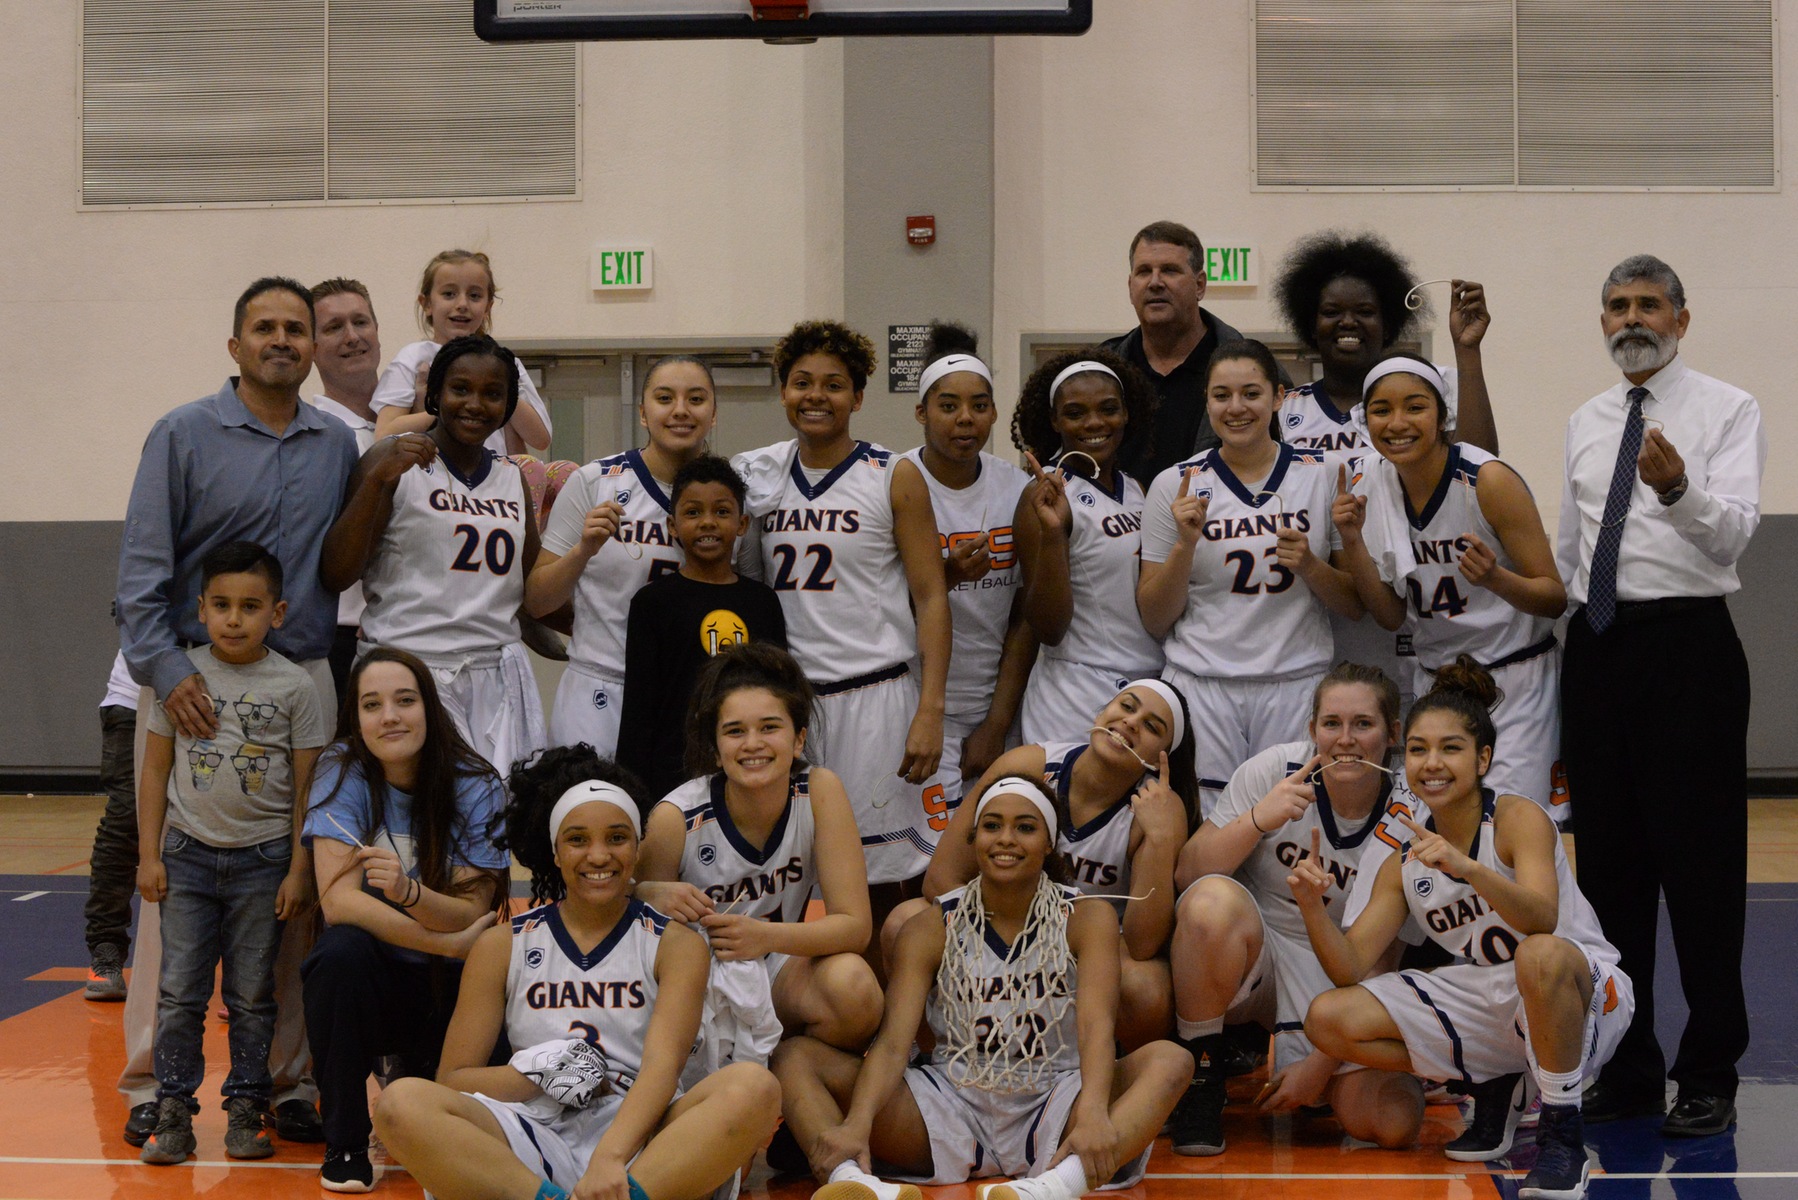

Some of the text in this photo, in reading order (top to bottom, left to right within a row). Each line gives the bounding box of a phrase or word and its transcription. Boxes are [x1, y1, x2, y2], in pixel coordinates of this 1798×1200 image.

[601, 251, 644, 284] EXIT
[1207, 247, 1251, 281] EXIT
[429, 488, 520, 523] GIANTS
[762, 508, 860, 534] GIANTS
[613, 520, 674, 547] GIA
[1102, 511, 1142, 538] GIAN
[1202, 509, 1310, 541] GIANTS
[449, 524, 516, 576] 20
[772, 543, 837, 592] 22
[1224, 546, 1295, 596] 23
[704, 856, 803, 903] GIANTS
[1063, 851, 1119, 887] NTS
[526, 979, 646, 1010] GIANTS
